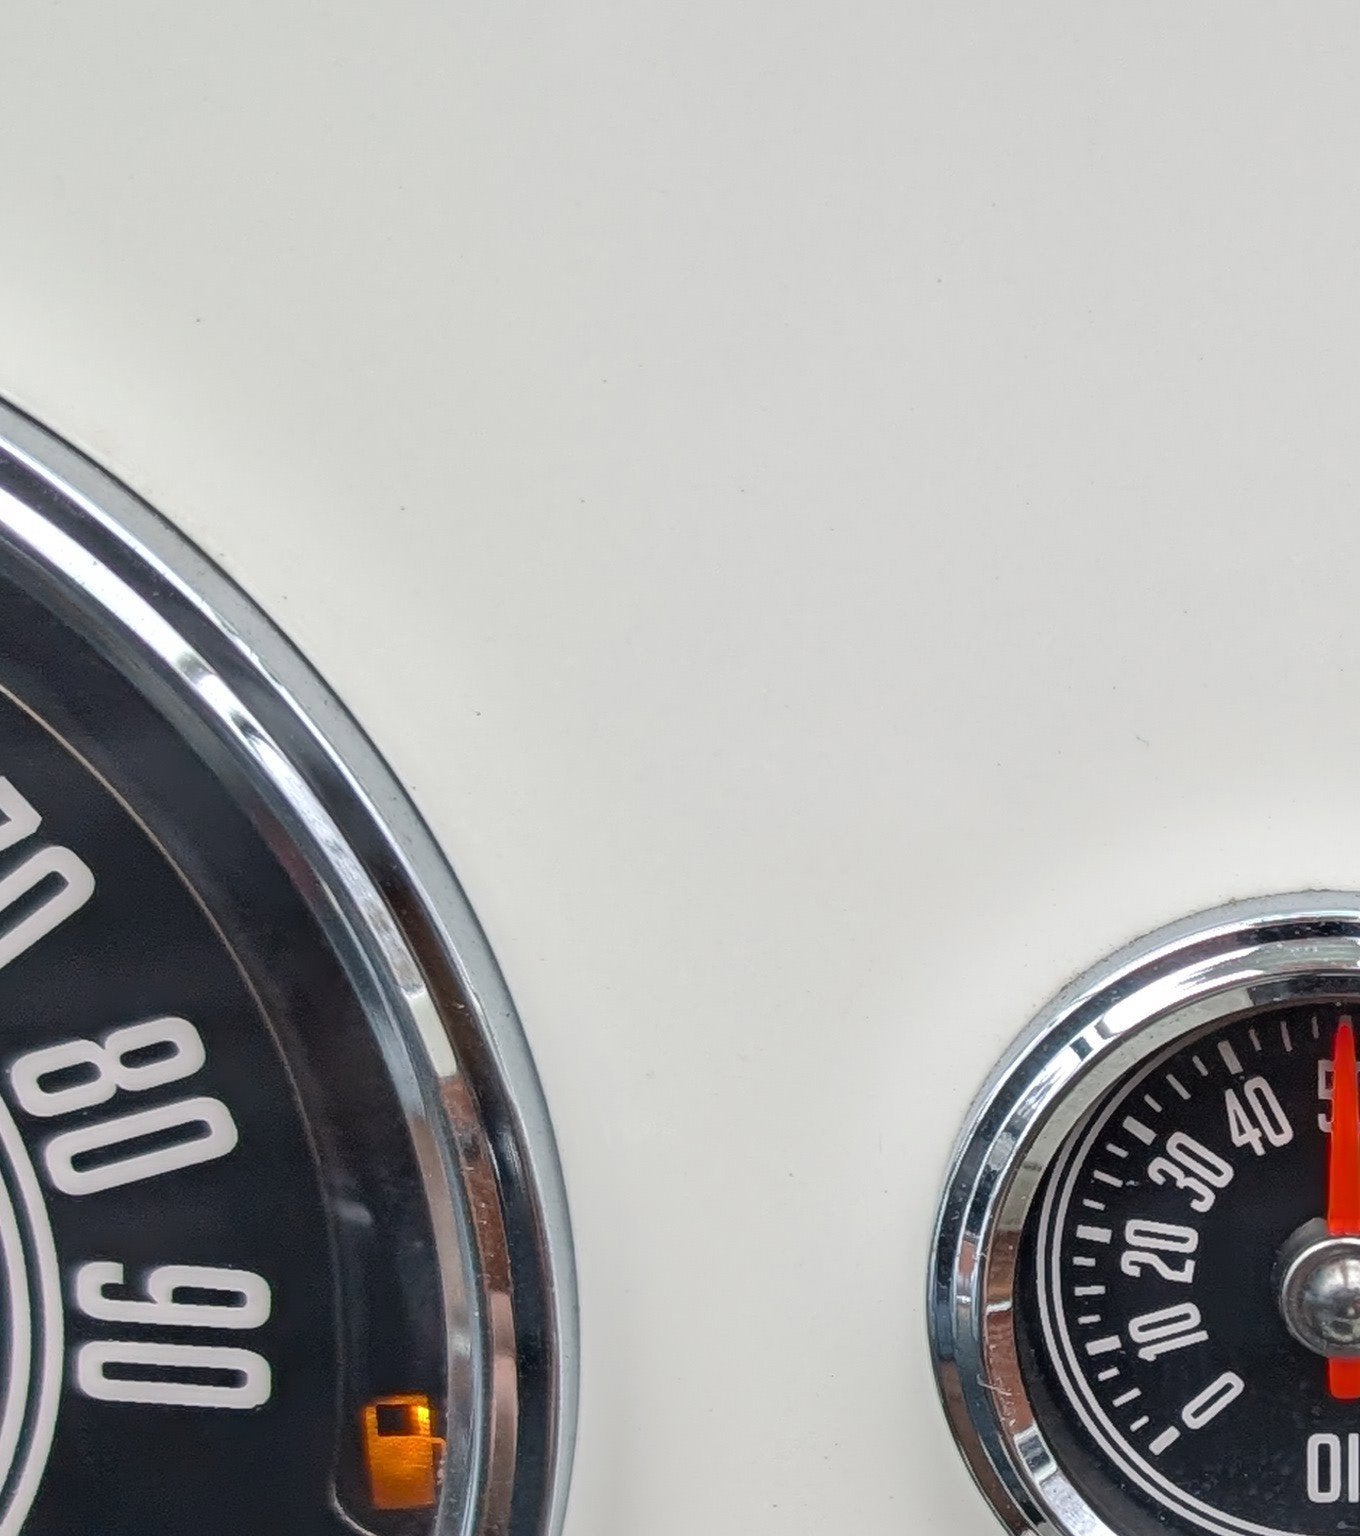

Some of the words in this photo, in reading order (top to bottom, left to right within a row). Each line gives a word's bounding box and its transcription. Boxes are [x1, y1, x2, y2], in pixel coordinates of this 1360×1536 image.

[0, 775, 96, 970] 0
[10, 1016, 239, 1196] 80
[1224, 1075, 1295, 1157] 40
[1147, 1131, 1235, 1213] 30
[1120, 1218, 1200, 1284] 20
[73, 1261, 273, 1411] 90
[1127, 1302, 1210, 1362] 10
[1181, 1370, 1245, 1430] 0
